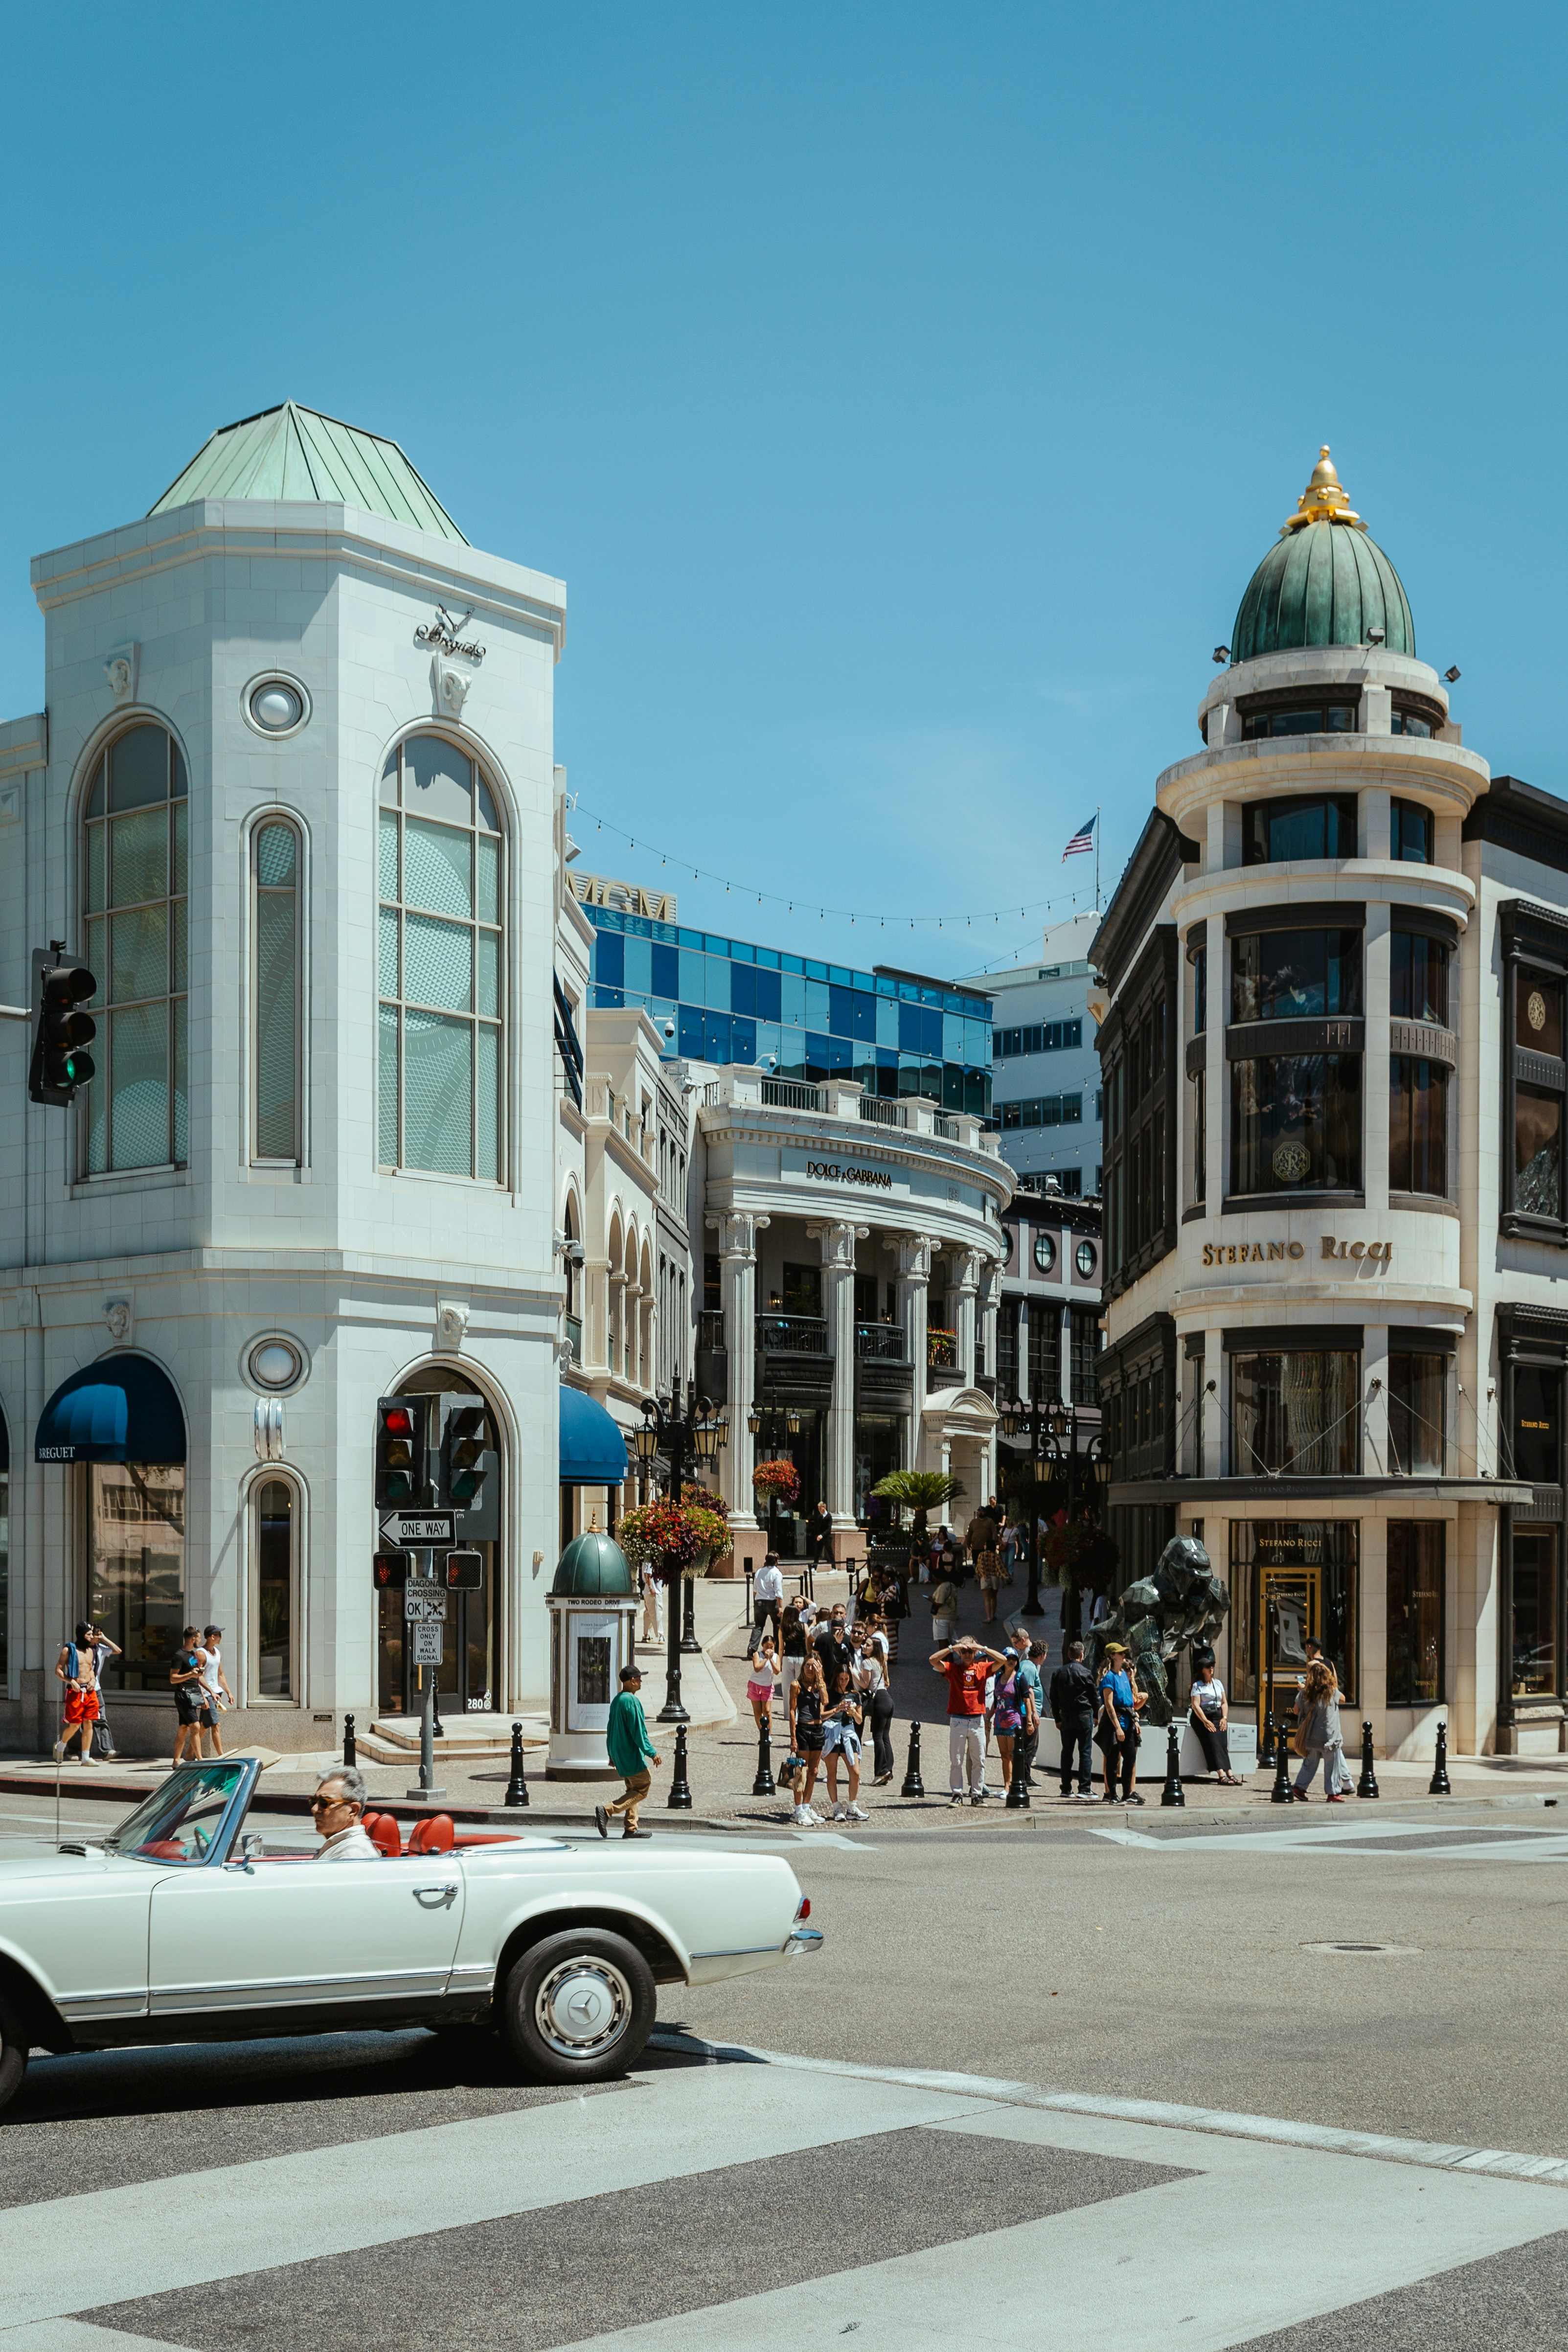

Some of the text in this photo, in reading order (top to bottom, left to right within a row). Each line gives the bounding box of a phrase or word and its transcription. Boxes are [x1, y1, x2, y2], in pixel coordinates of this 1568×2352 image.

[566, 870, 672, 922] MGM
[1202, 1236, 1393, 1266] STEFANO RICCI
[39, 1446, 75, 1459] BREGUET
[401, 1522, 445, 1536] ONE WAY
[1259, 1538, 1321, 1547] STEFANO RICCI
[407, 1602, 421, 1616] OK
[467, 1698, 483, 1710] 280
